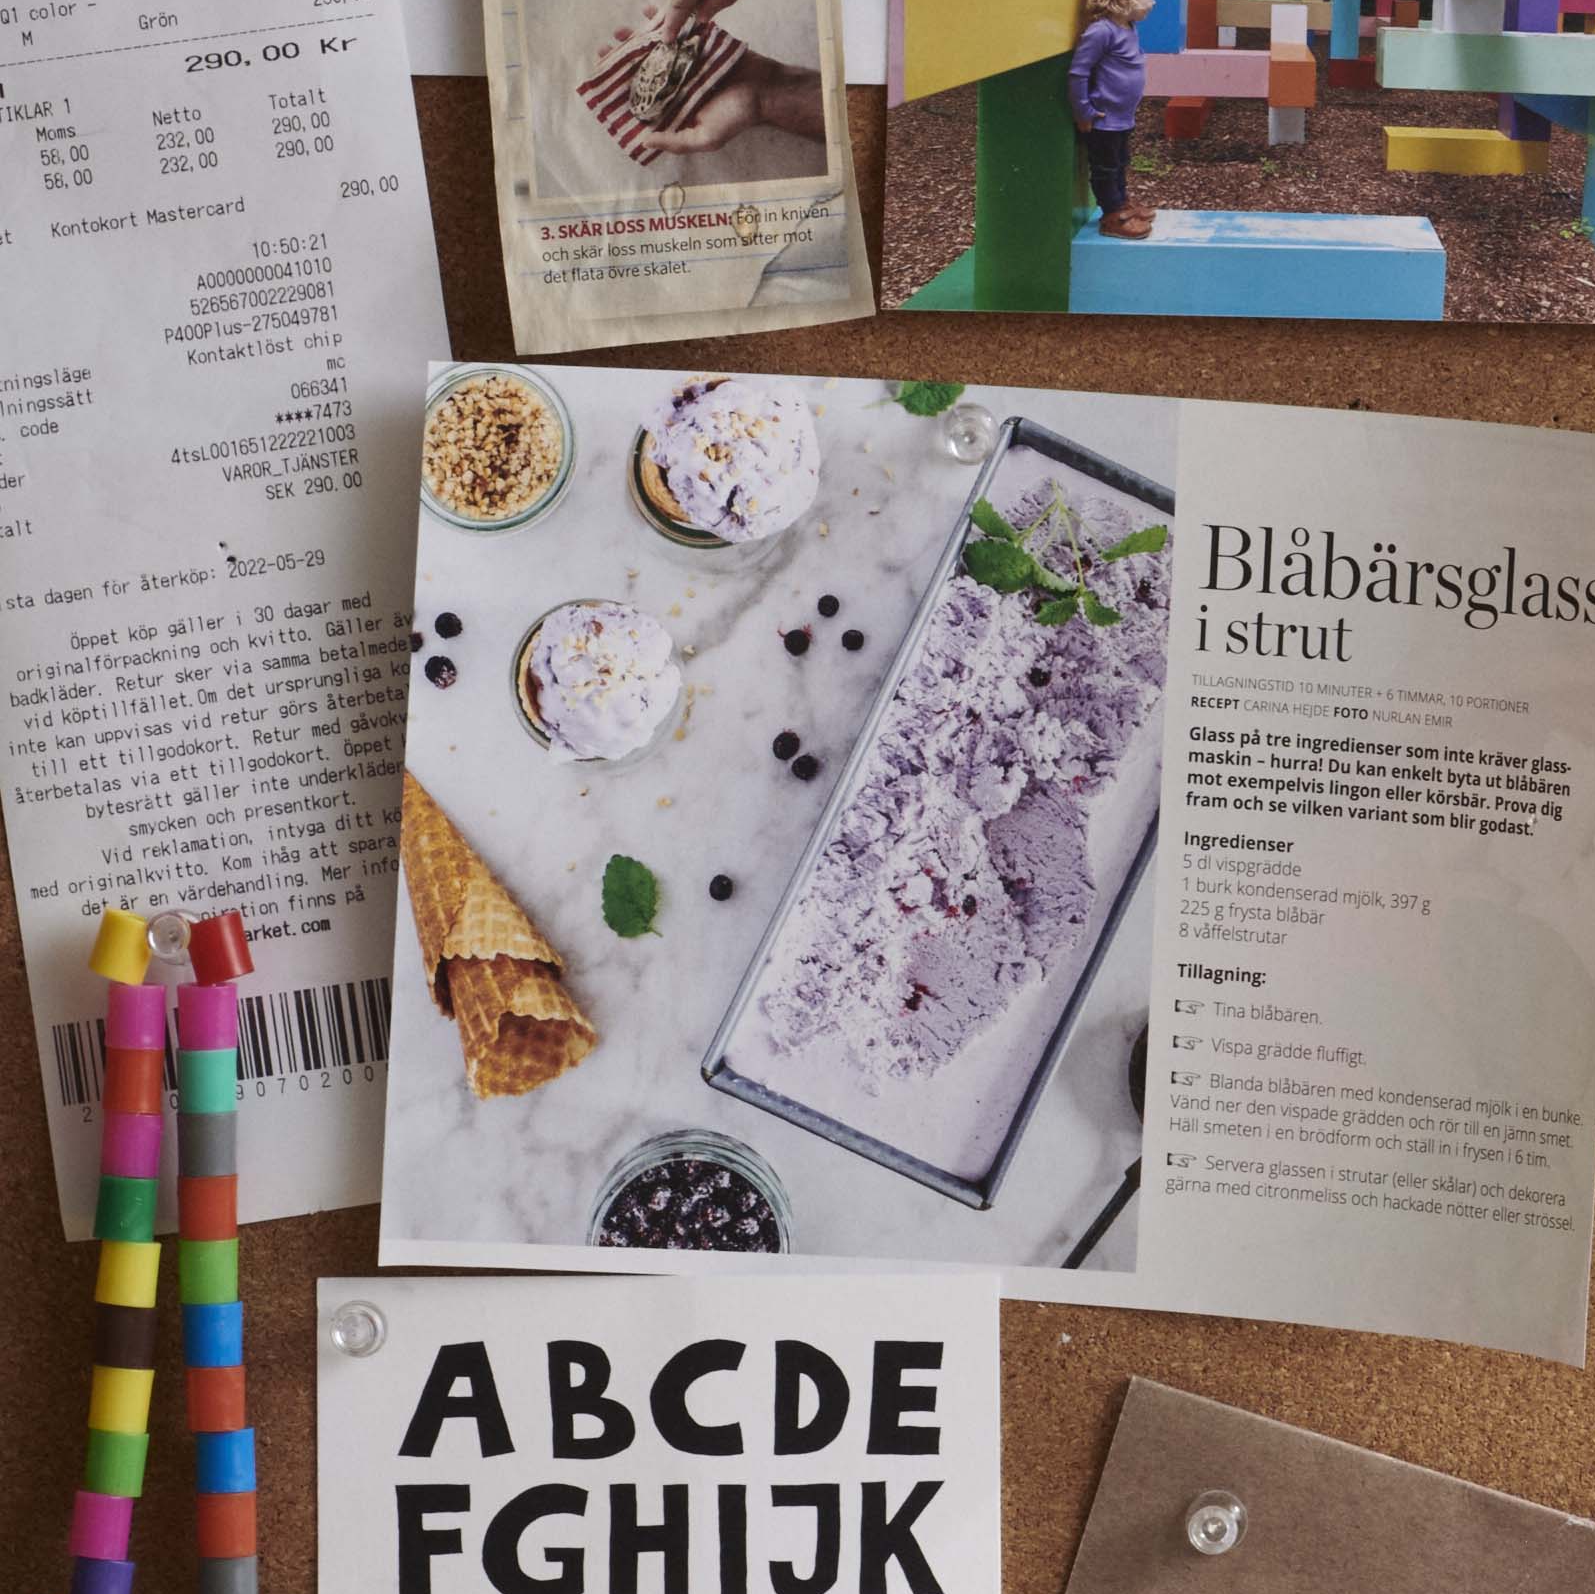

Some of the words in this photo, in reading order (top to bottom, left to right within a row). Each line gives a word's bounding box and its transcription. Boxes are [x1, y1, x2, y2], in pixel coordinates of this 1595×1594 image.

[51, 212, 139, 238] Kontokort
[146, 197, 245, 225] Mastercard
[541, 227, 556, 240] 3.
[558, 217, 603, 239] SKÄR
[606, 219, 646, 235] LOSS
[648, 213, 732, 231] MUSKELN:
[187, 340, 295, 366] Kontaktlöst
[304, 332, 343, 351] chip
[221, 448, 360, 482] VAROR_TJÄNSTER
[227, 550, 326, 579] 2022-05-29
[1194, 605, 1209, 653] i
[1225, 611, 1353, 663] strut
[1191, 696, 1240, 711] RECEPT
[1243, 700, 1290, 715] CARINA
[1293, 704, 1331, 718] HEJDE
[1333, 707, 1369, 721] FOTO
[1372, 710, 1422, 725] NURLAN
[1424, 714, 1453, 728] EMIR
[1189, 726, 1235, 744] Glass
[1240, 728, 1261, 748] på
[1266, 732, 1292, 748] tre
[1296, 734, 1402, 757] ingredienser
[1406, 743, 1439, 761] som
[1443, 748, 1475, 765] inte
[1478, 750, 1528, 770] kräver
[1531, 757, 1572, 775] glass-
[129, 815, 198, 837] smycken
[206, 810, 237, 825] och
[244, 791, 357, 819] presentkort.
[1184, 831, 1294, 854] Ingredienser
[1177, 963, 1267, 986] Tillagning:
[1213, 1002, 1246, 1020] Tina
[1251, 1005, 1323, 1026] blåbären.
